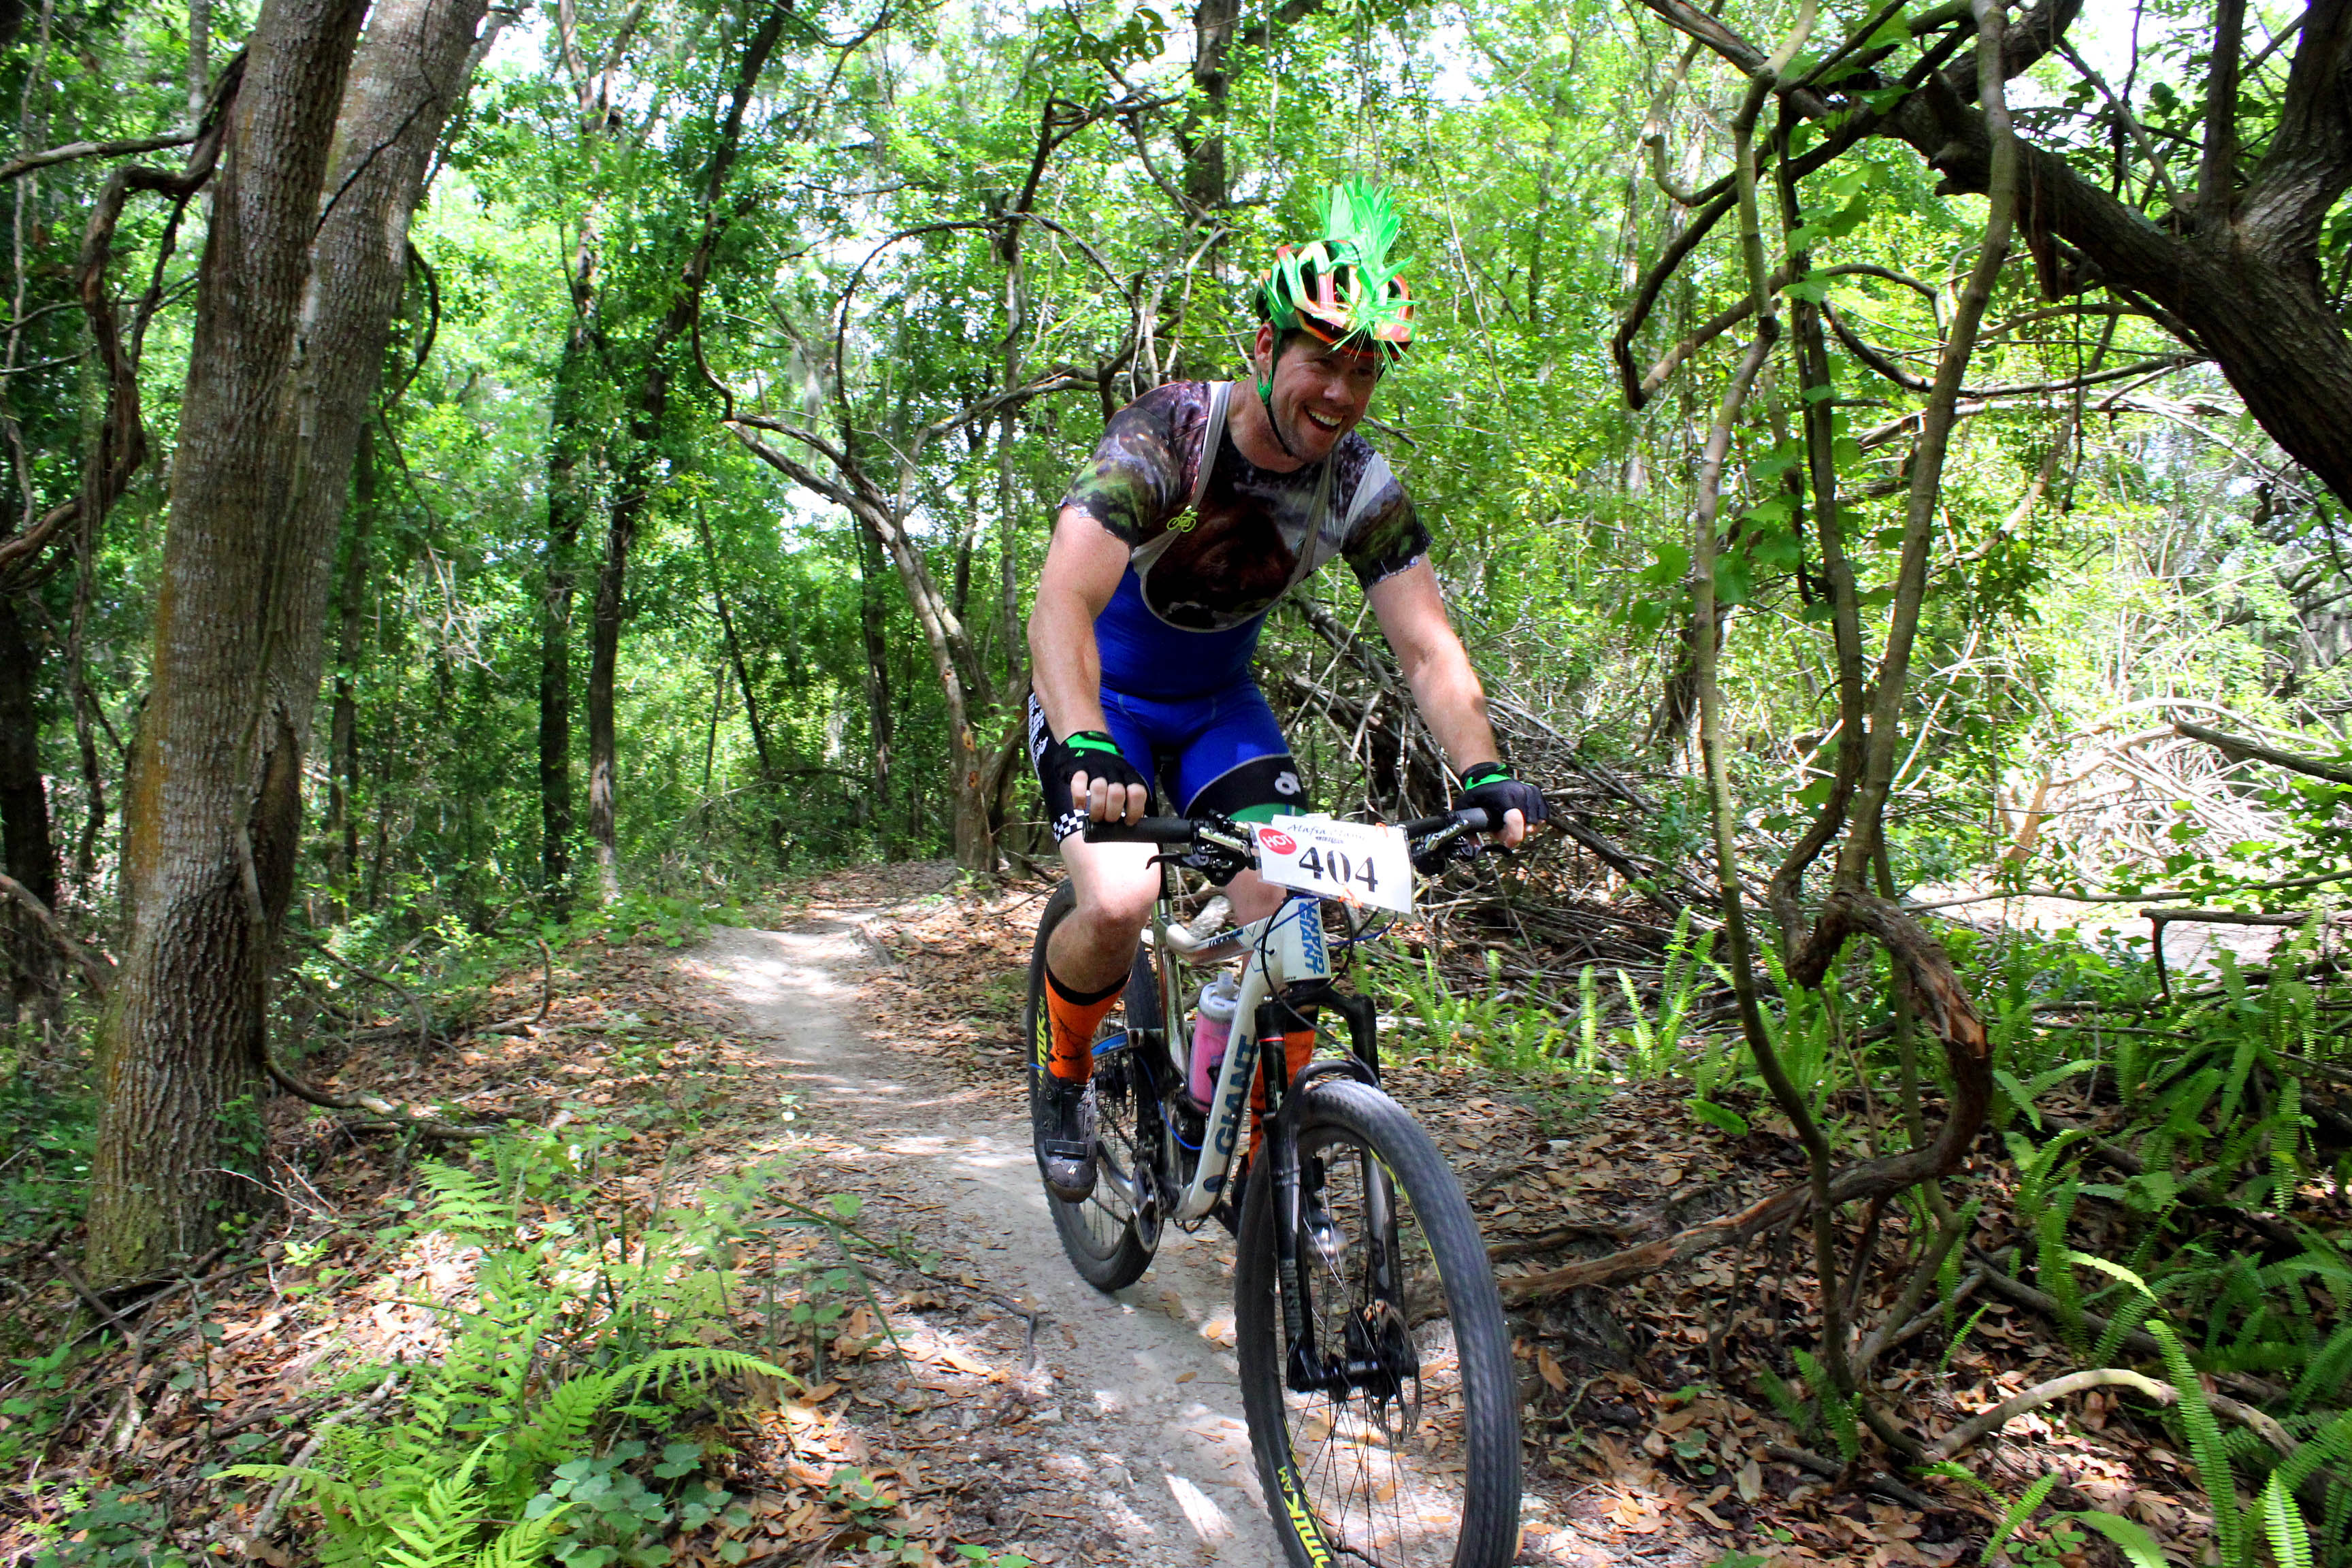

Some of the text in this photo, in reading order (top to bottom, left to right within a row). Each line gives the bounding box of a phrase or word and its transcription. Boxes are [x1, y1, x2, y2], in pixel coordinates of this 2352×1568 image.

[1261, 834, 1292, 848] HOT
[1298, 846, 1379, 893] 404
[1298, 902, 1317, 974] GIANT
[1215, 1034, 1259, 1156] GIANT
[1277, 1465, 1295, 1493] AM
